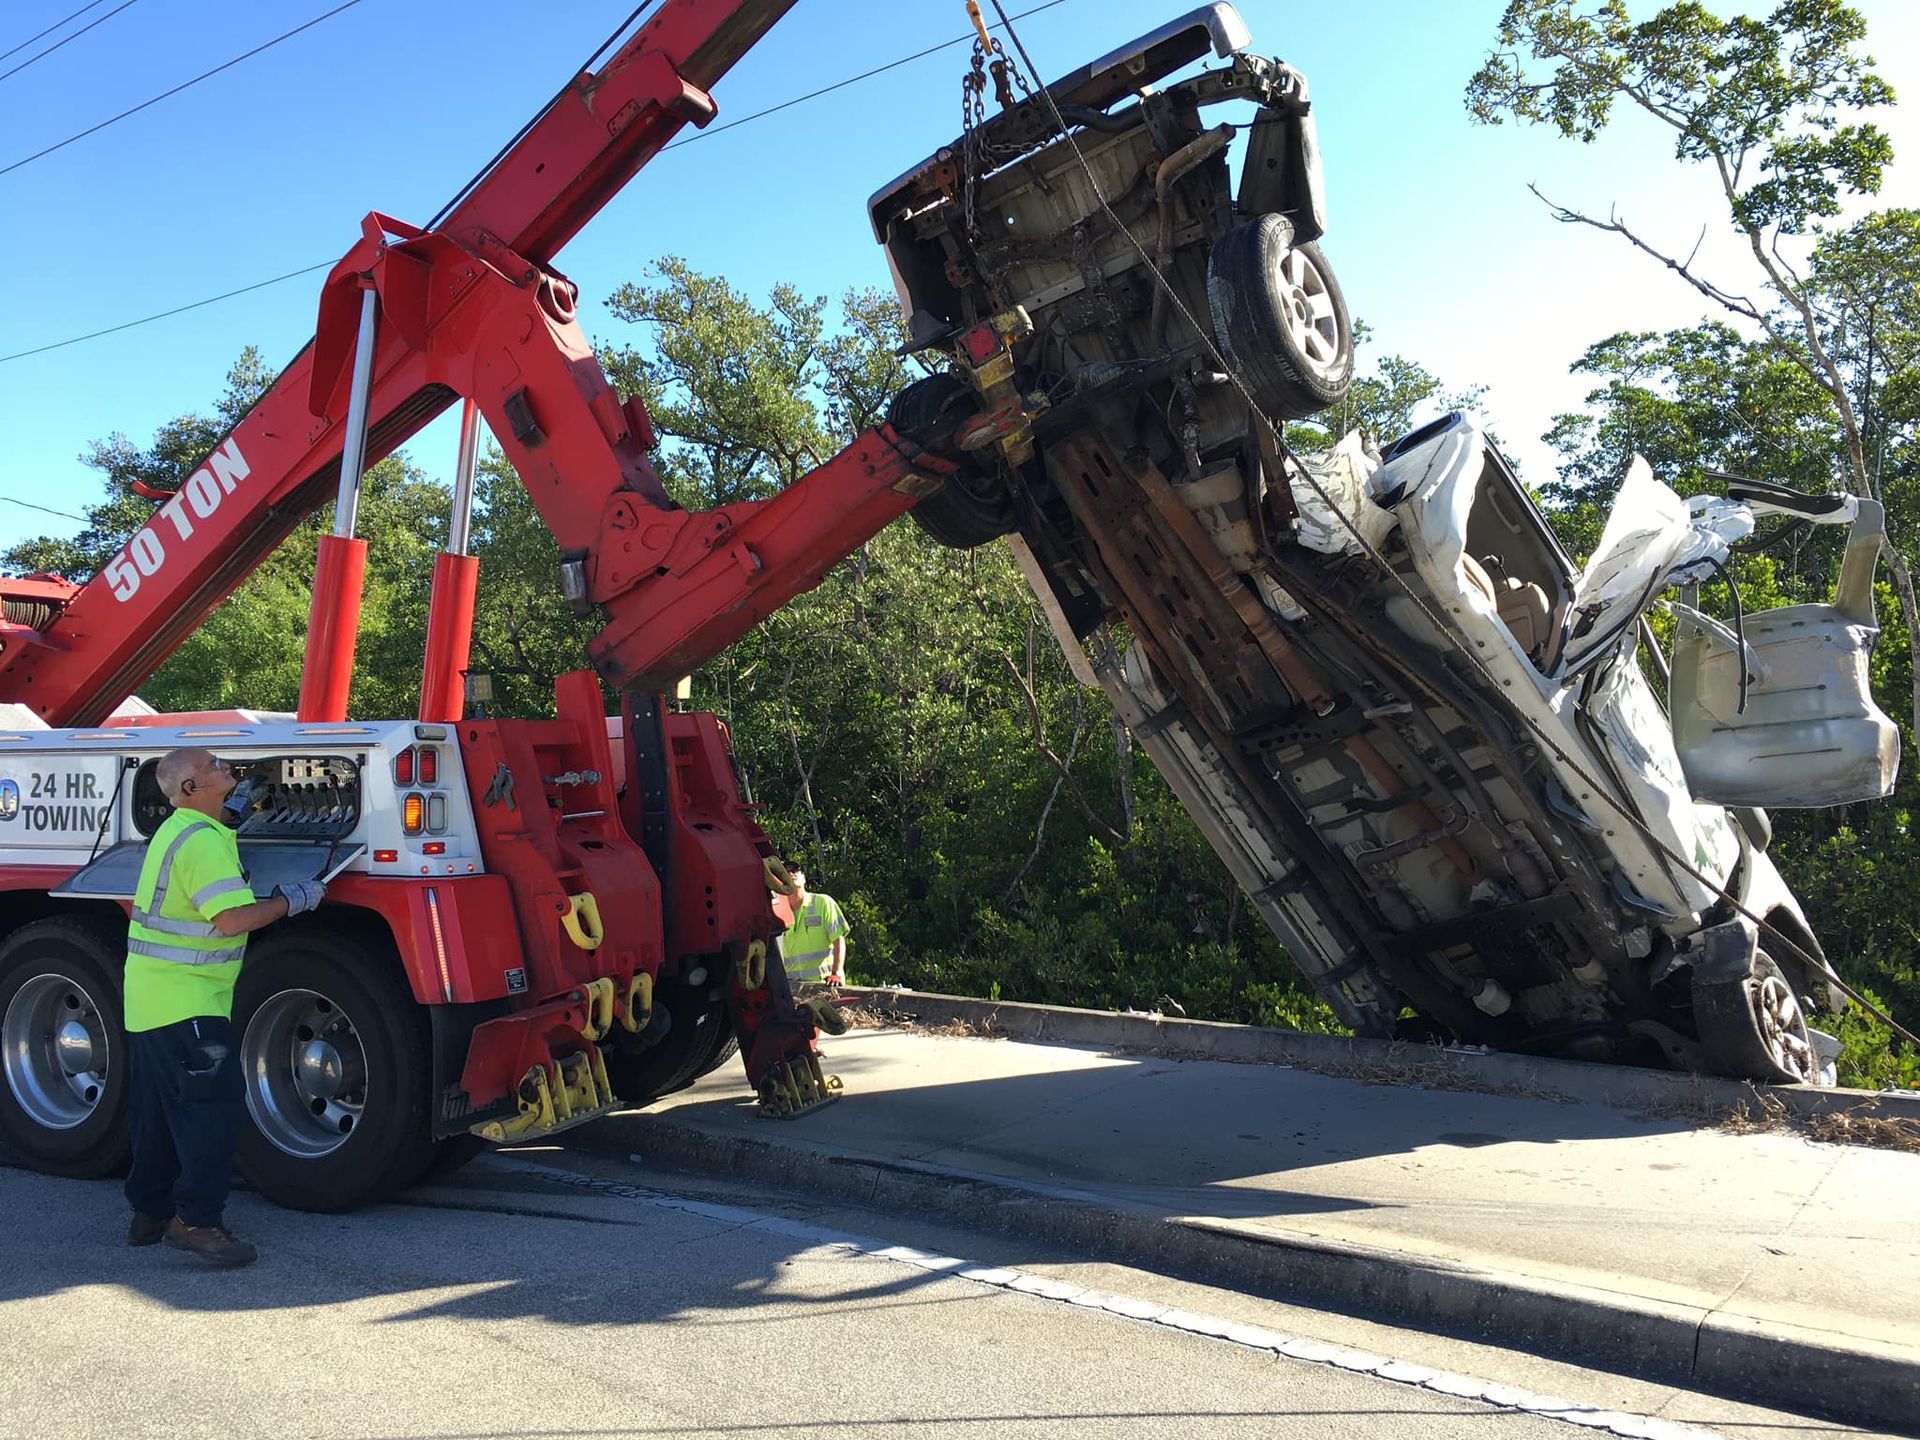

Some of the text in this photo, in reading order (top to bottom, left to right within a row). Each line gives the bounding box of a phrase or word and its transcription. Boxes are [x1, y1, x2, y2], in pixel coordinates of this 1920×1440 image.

[103, 438, 250, 602] 50 TON
[30, 773, 104, 799] 24 HR.
[21, 805, 111, 833] TOWING
